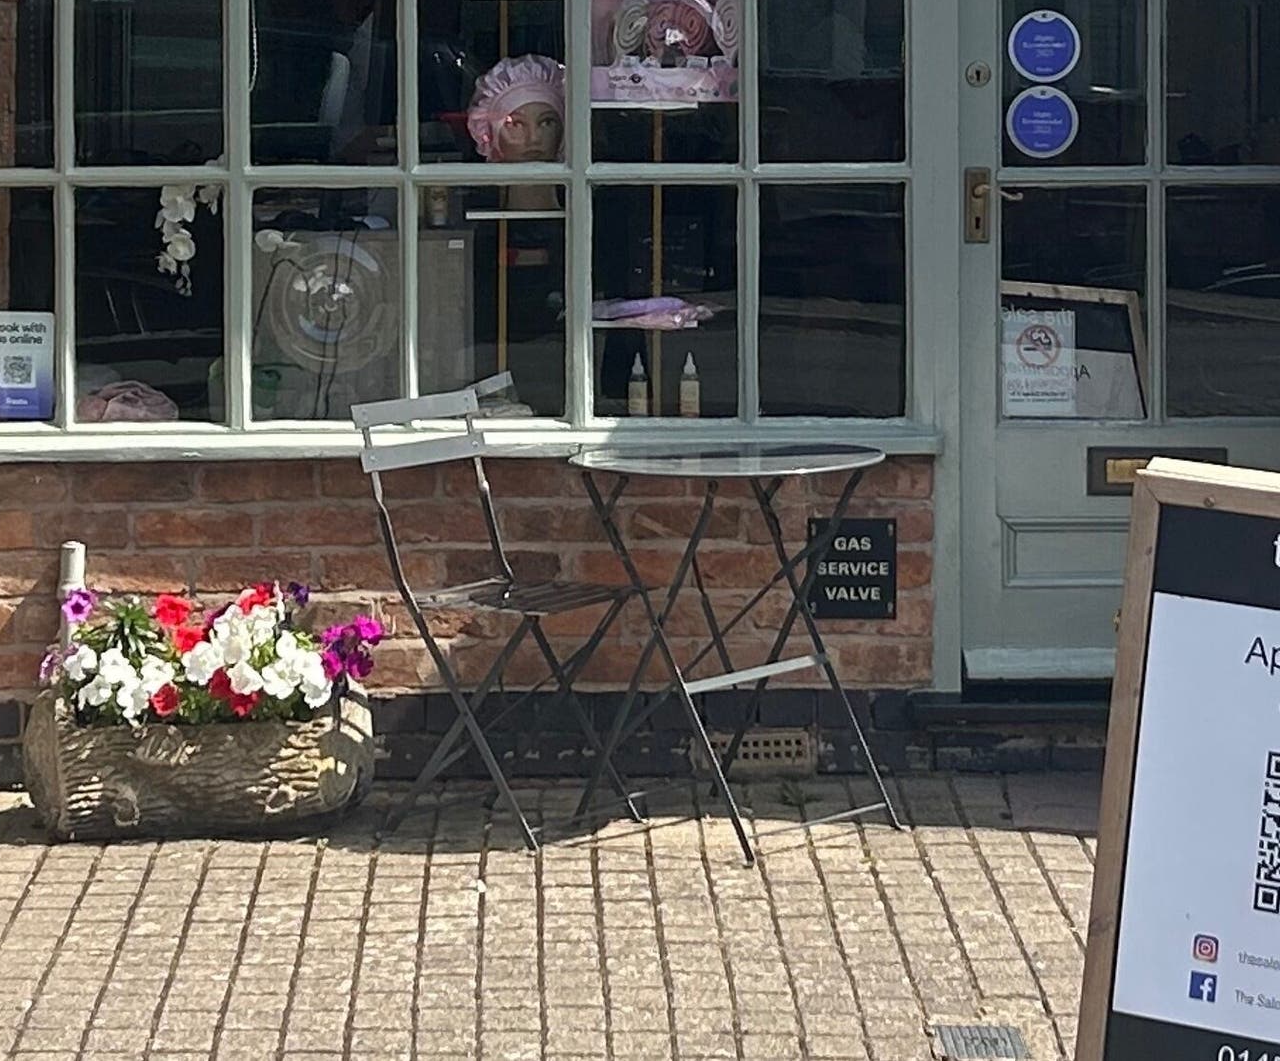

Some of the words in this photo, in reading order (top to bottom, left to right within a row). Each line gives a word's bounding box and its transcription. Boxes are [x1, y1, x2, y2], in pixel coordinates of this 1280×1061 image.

[21, 322, 47, 333] with
[9, 333, 43, 344] online
[833, 536, 872, 551] GAS
[816, 560, 889, 576] SERVICE
[824, 585, 881, 601] VALVE
[1234, 988, 1255, 1006] The
